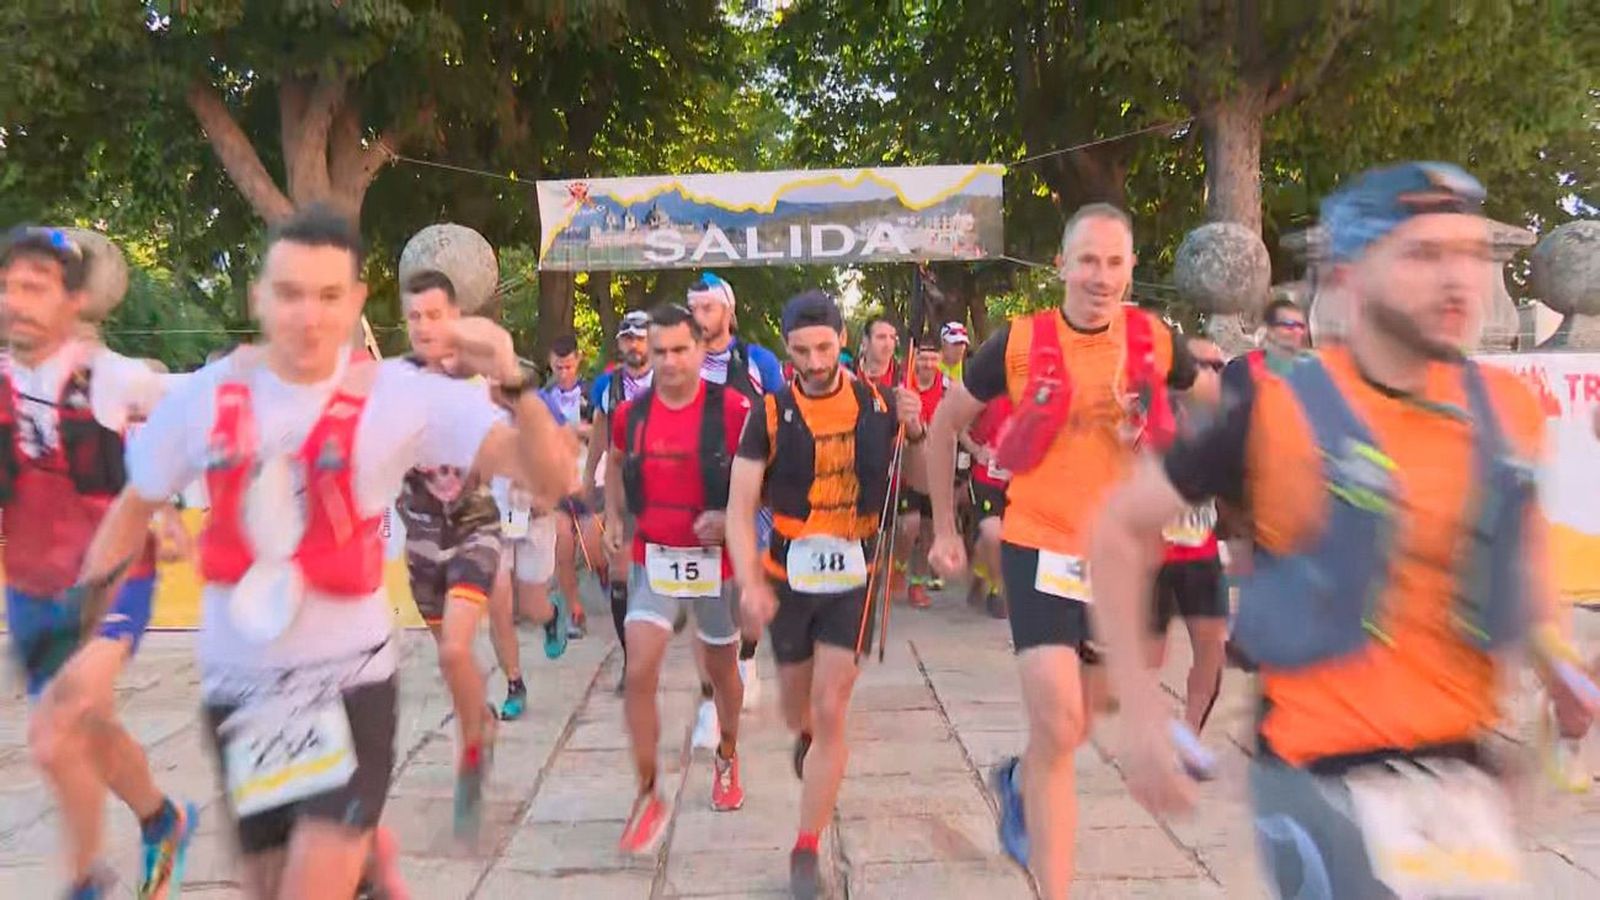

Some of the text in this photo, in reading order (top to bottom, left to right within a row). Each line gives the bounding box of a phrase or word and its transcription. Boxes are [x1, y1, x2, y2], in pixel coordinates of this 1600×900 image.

[643, 222, 912, 263] SALIDA
[669, 561, 700, 581] 15
[810, 551, 846, 572] 38
